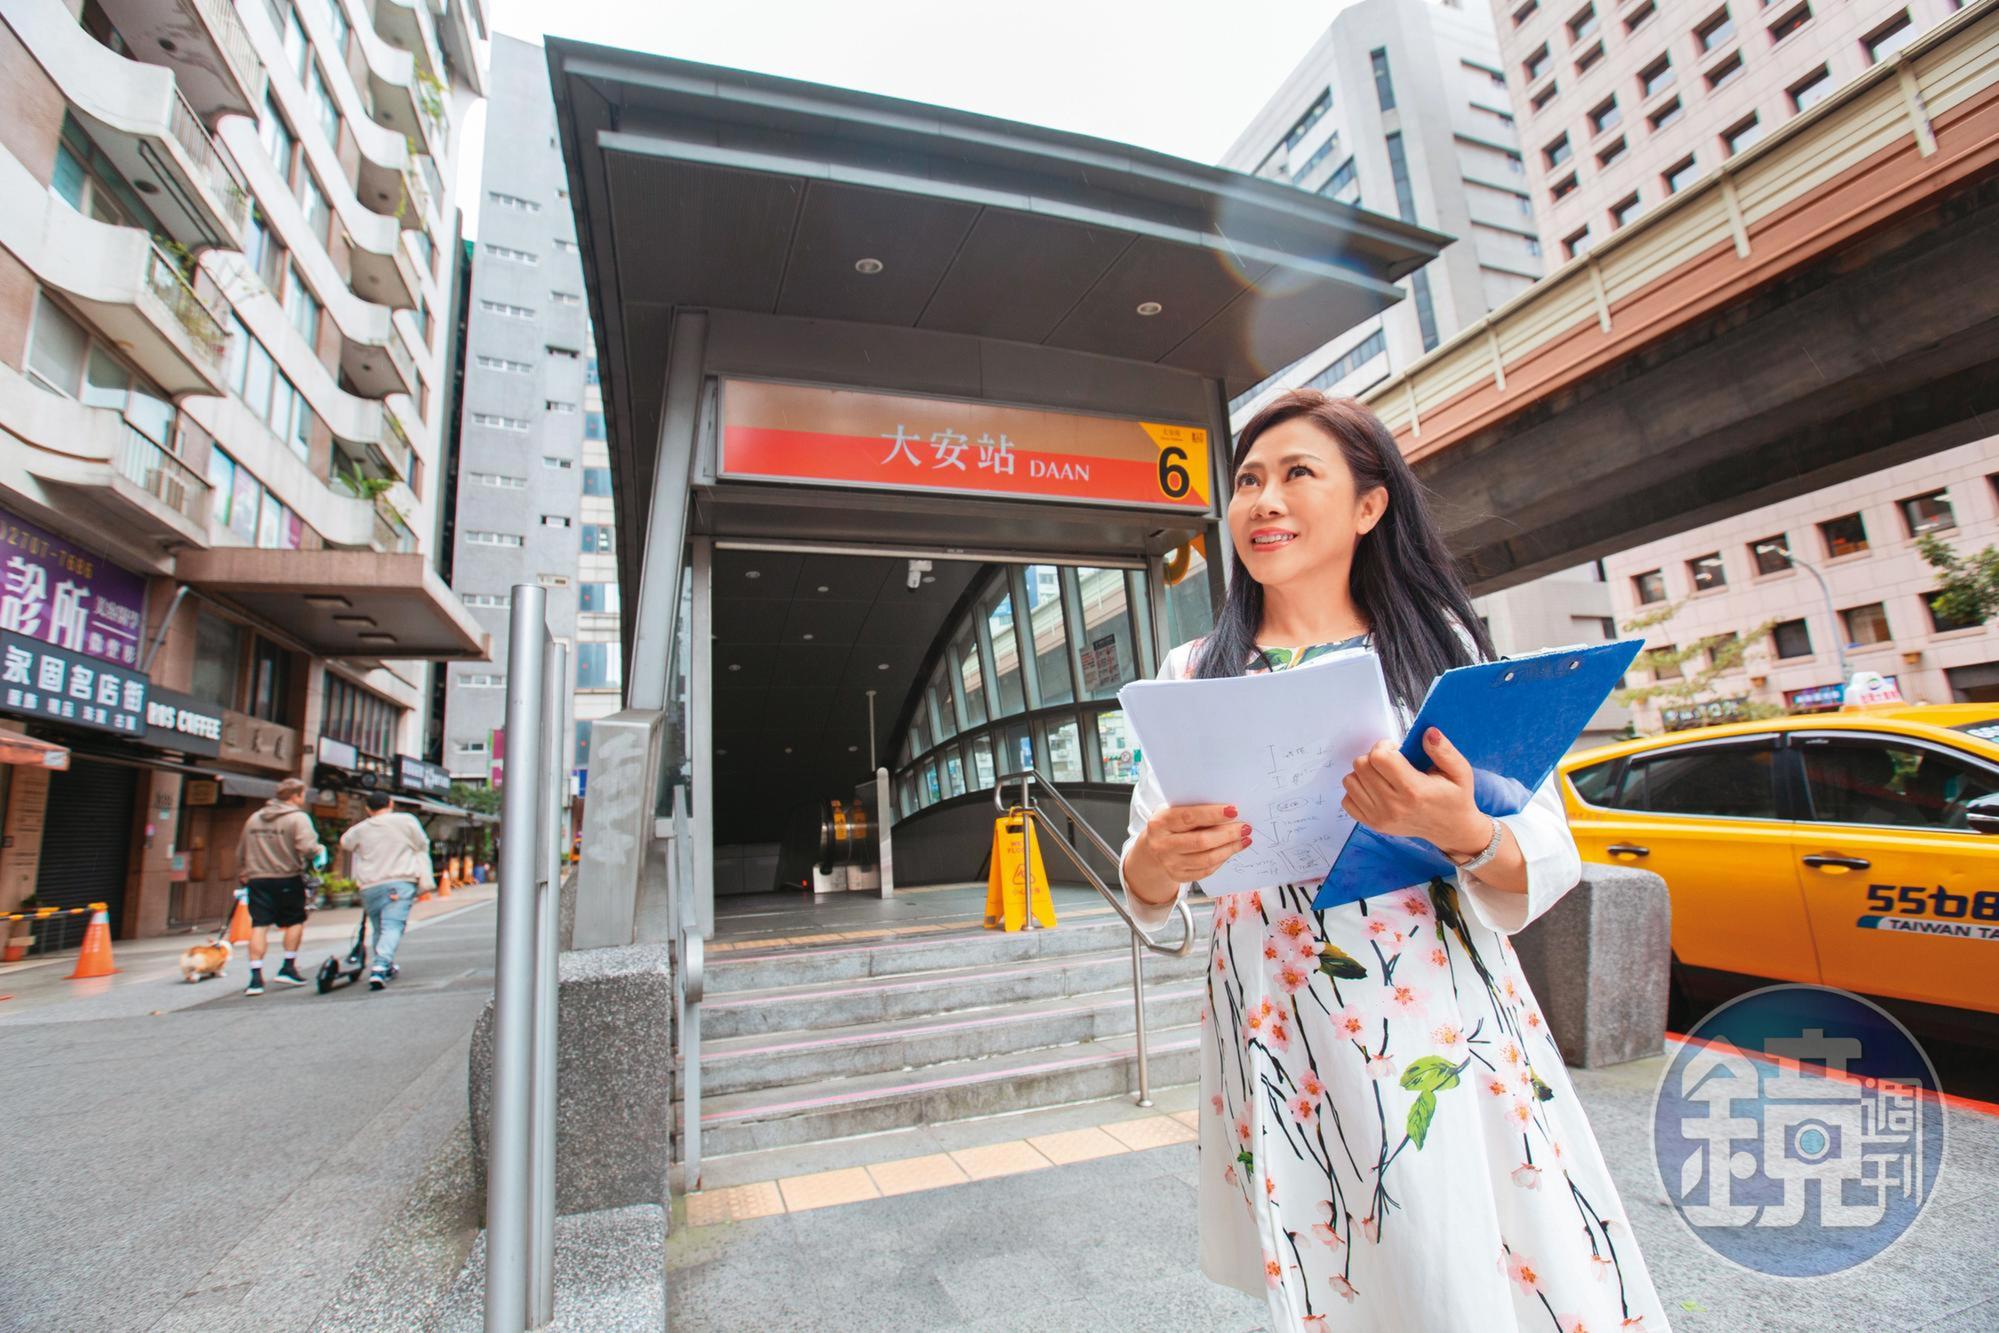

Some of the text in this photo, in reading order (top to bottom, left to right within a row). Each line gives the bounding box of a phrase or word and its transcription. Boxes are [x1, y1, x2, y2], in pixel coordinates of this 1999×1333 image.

[880, 424, 1015, 475] 大安站
[1029, 459, 1090, 481] DAAN
[1158, 446, 1190, 499] 6
[176, 709, 222, 740] COFFEE
[1889, 918, 1971, 937] TAIWAN
